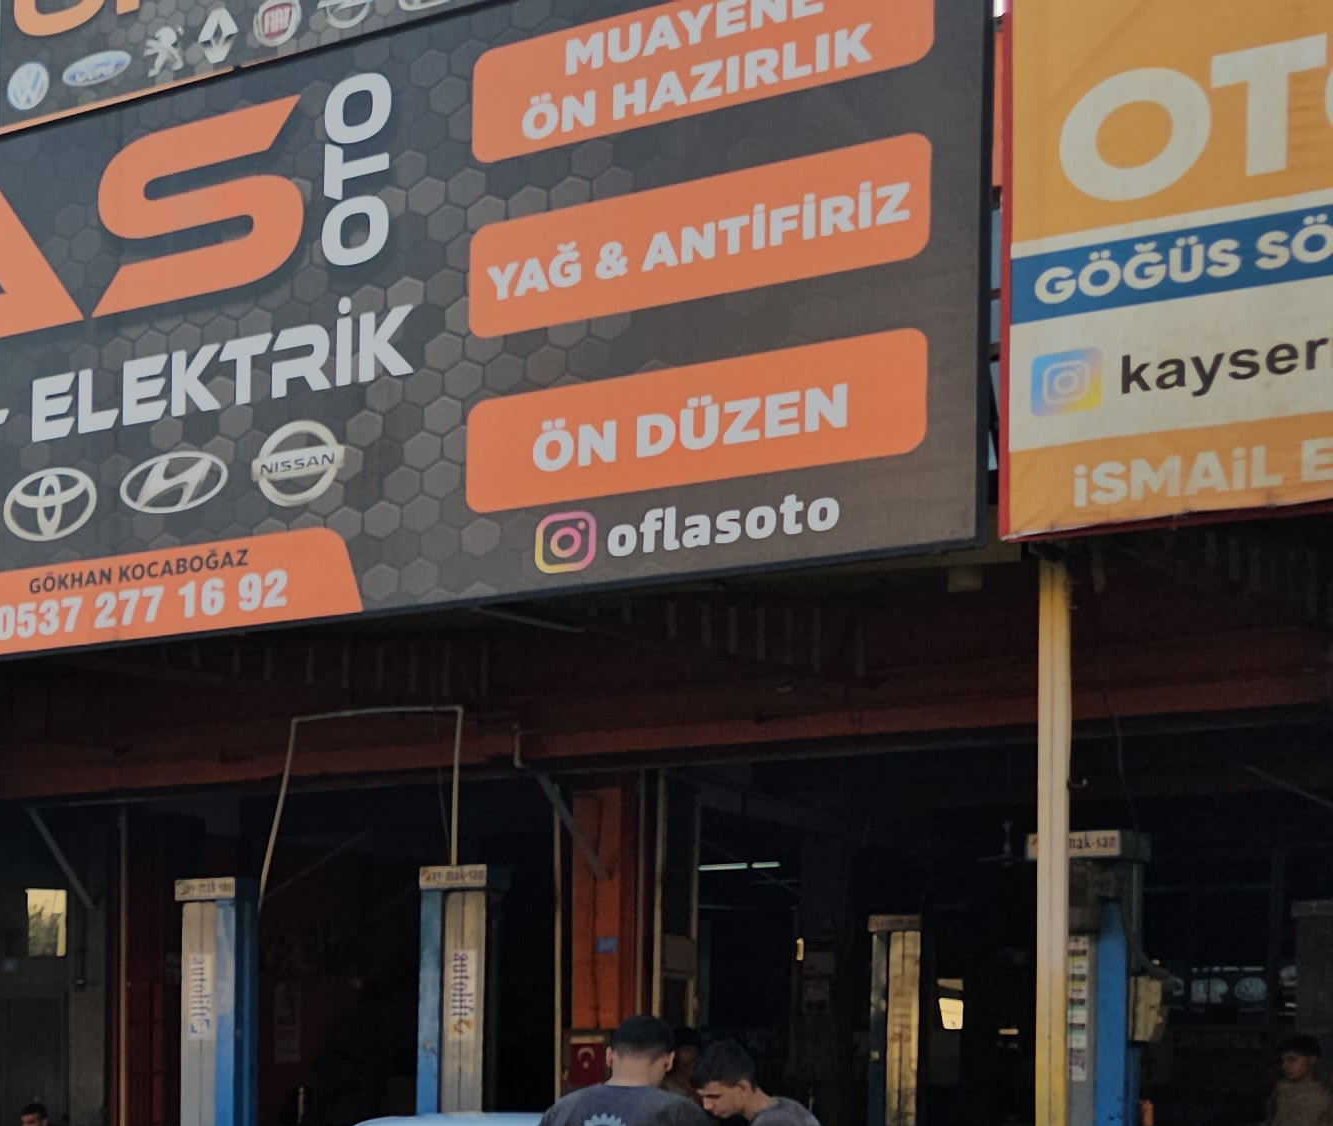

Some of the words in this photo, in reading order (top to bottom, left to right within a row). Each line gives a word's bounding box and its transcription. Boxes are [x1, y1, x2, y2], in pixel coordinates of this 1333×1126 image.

[522, 90, 596, 141] ÖN
[613, 22, 873, 121] HAZIRLIK
[1058, 33, 1333, 202] OT
[322, 72, 391, 266] OTO
[487, 241, 582, 300] YAĞ
[595, 241, 629, 280] &
[641, 181, 910, 273] ANTİFİRİZ
[1034, 236, 1241, 304] GÖĞÜS
[32, 296, 416, 442] ELEKTRİK
[260, 451, 335, 474] NISSAN
[533, 417, 618, 473] ÖN
[636, 383, 849, 460] DÜZEN
[607, 493, 841, 558] oflasoto
[29, 567, 112, 594] GÖKHAN
[118, 548, 249, 585] KOCABOĞAZ
[94, 587, 162, 629] 277
[180, 578, 225, 616] 16
[238, 569, 288, 611] 92
